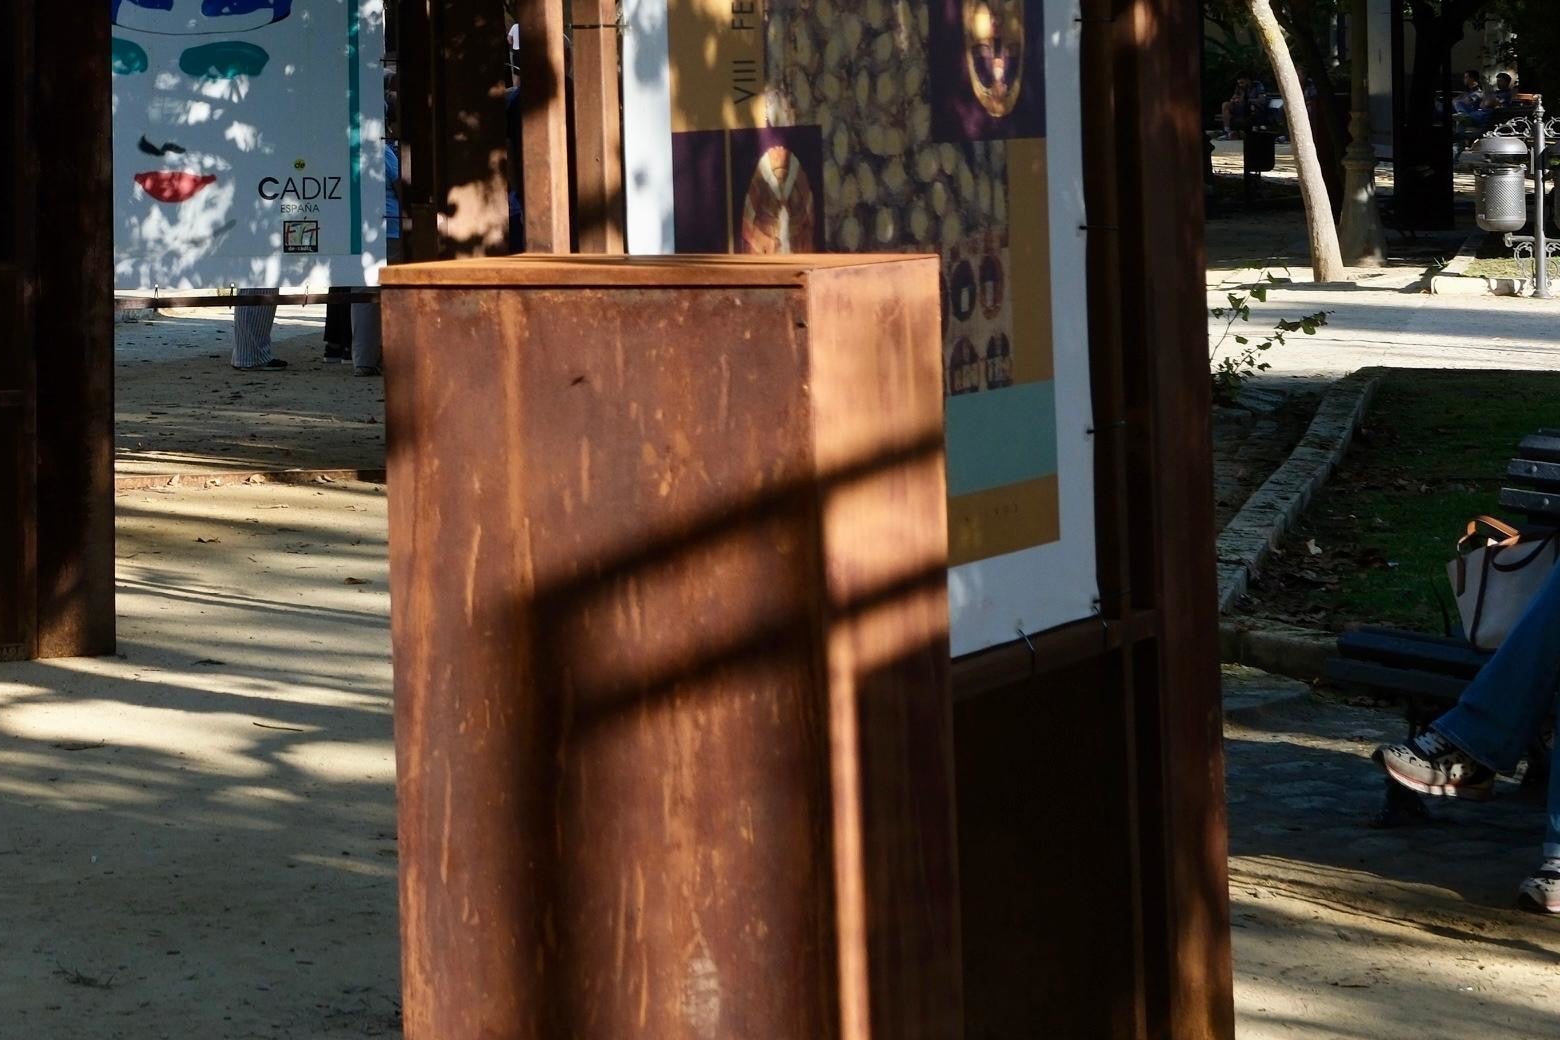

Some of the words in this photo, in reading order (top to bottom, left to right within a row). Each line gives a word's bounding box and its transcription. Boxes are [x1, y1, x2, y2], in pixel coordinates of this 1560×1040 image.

[733, 60, 757, 104] VIII
[258, 176, 342, 200] CADIZ
[280, 202, 320, 213] ESPAÑA
